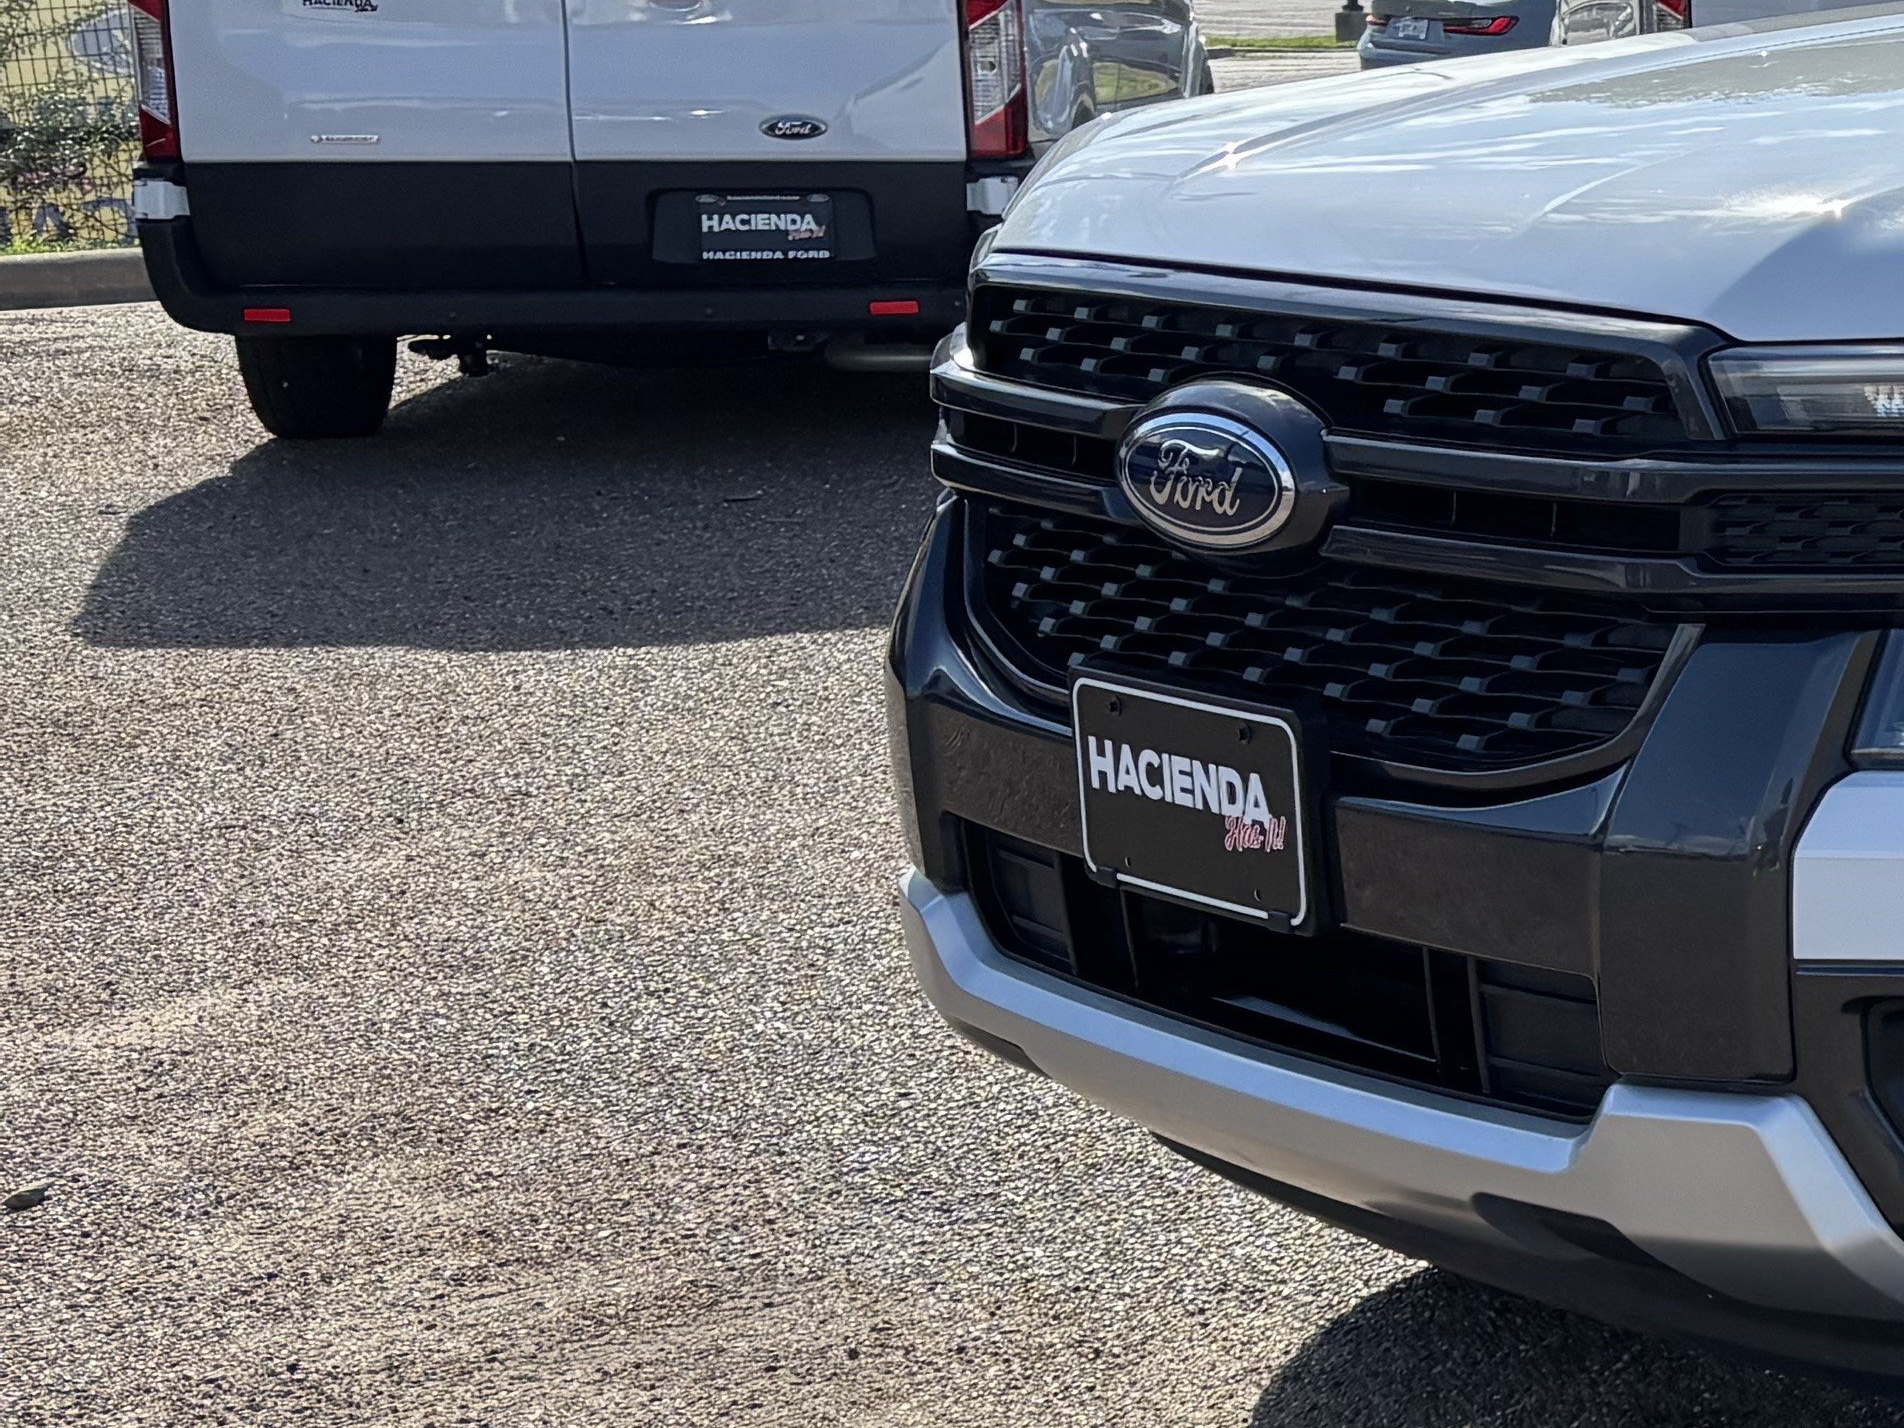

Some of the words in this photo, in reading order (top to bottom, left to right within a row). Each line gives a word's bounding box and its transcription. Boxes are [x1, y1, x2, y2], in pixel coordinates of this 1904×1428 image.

[701, 213, 817, 233] HACIENDA
[702, 250, 785, 260] HACIENDA
[787, 250, 830, 259] FORD
[1149, 439, 1241, 518] Ford
[1087, 733, 1272, 827] HACIENDA
[1224, 815, 1264, 853] Has
